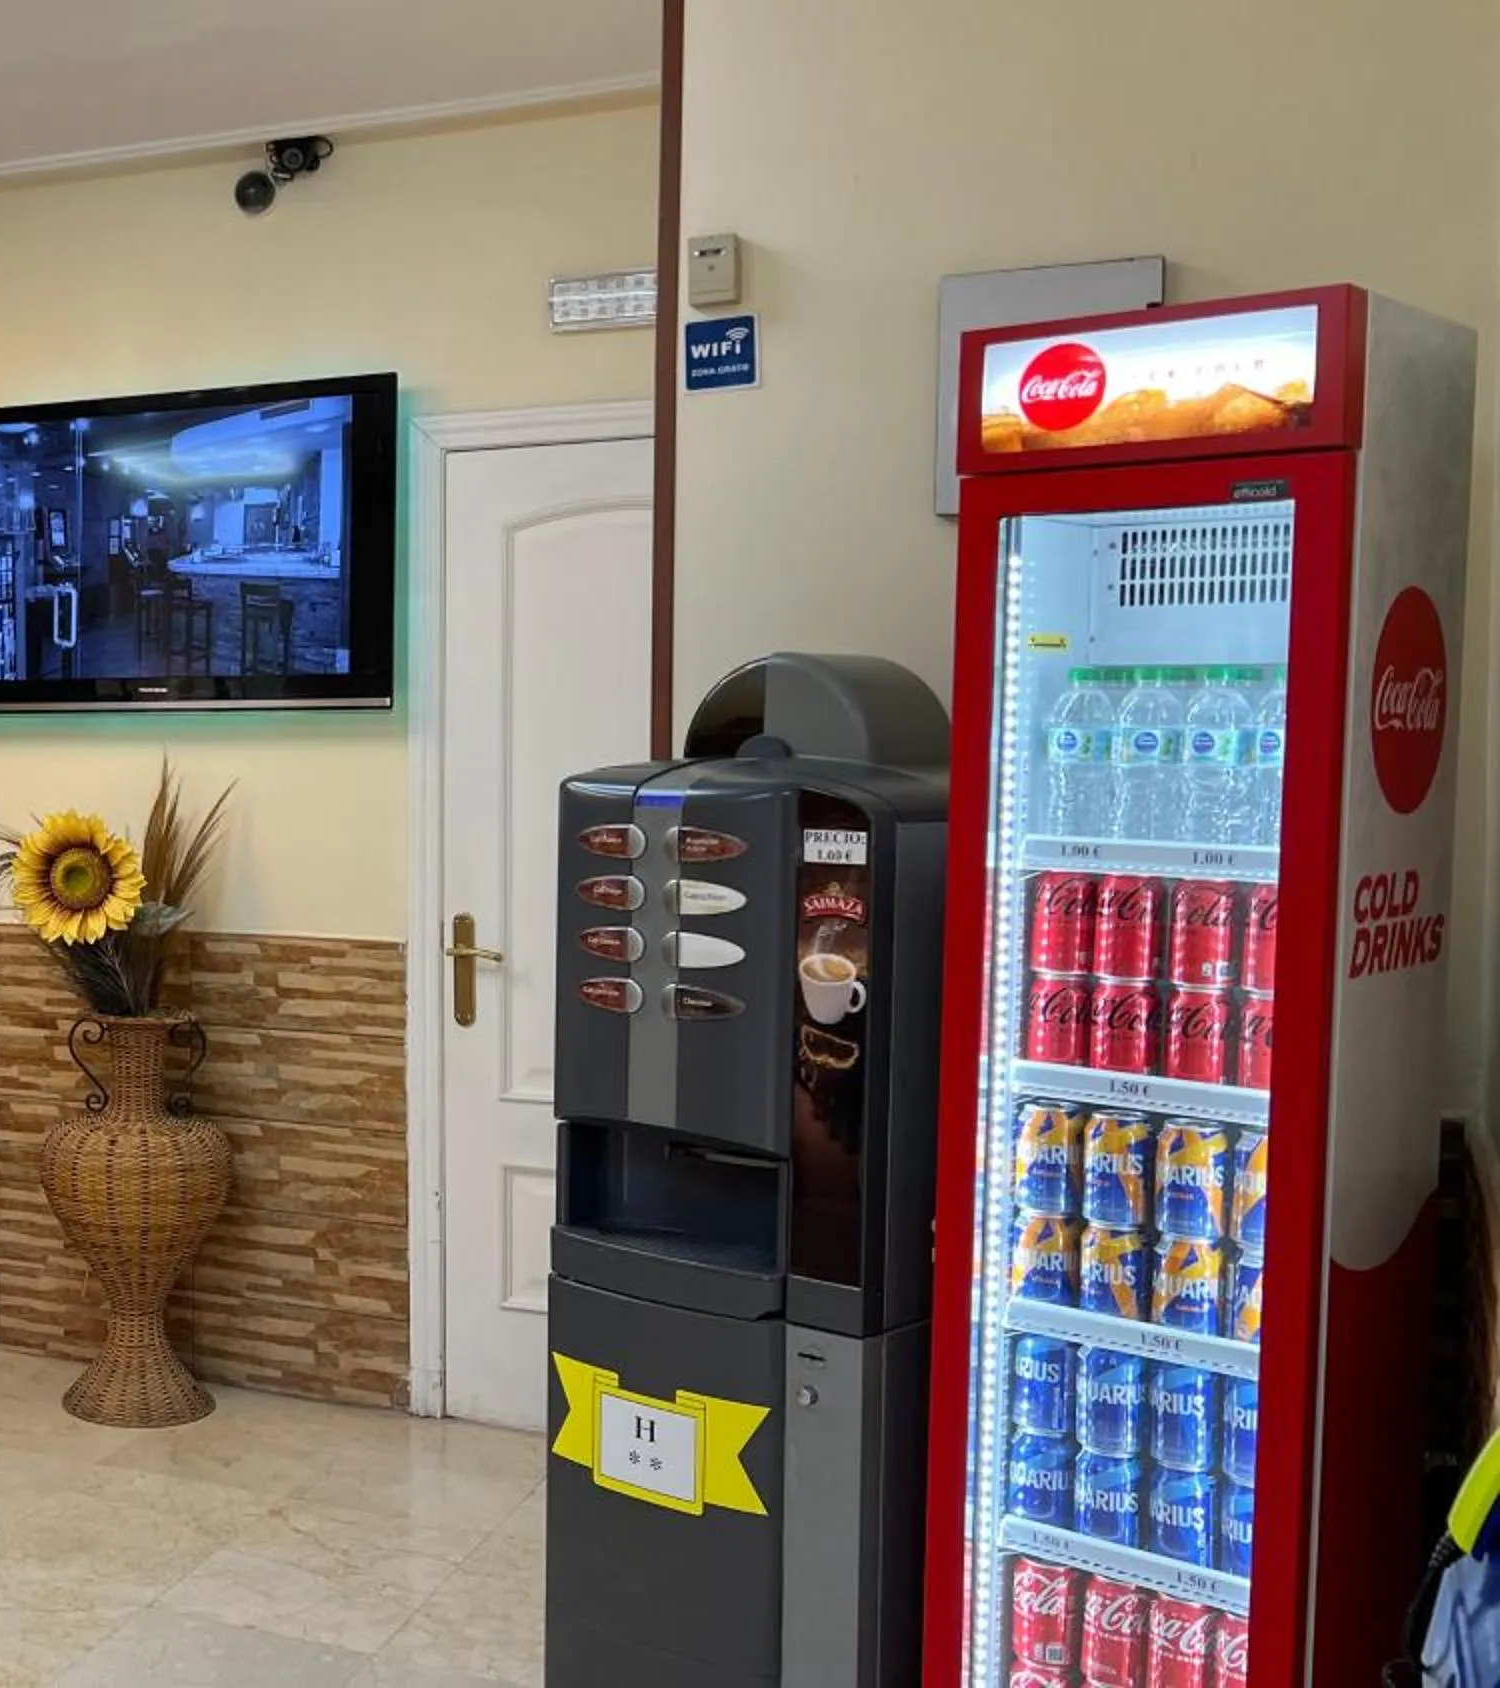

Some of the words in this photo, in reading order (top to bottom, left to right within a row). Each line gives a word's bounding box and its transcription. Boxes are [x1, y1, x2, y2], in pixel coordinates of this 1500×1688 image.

[1373, 663, 1444, 734] Coca-Cola
[1192, 852, 1223, 866] 1.00
[803, 893, 865, 917] SAIMAZA
[1352, 869, 1420, 925] COLD
[1347, 913, 1446, 981] DRINKS
[1108, 1080, 1140, 1096] 1.50
[1140, 1331, 1171, 1350] 1.50
[634, 1415, 657, 1443] H
[1176, 1571, 1206, 1589] 1.50
